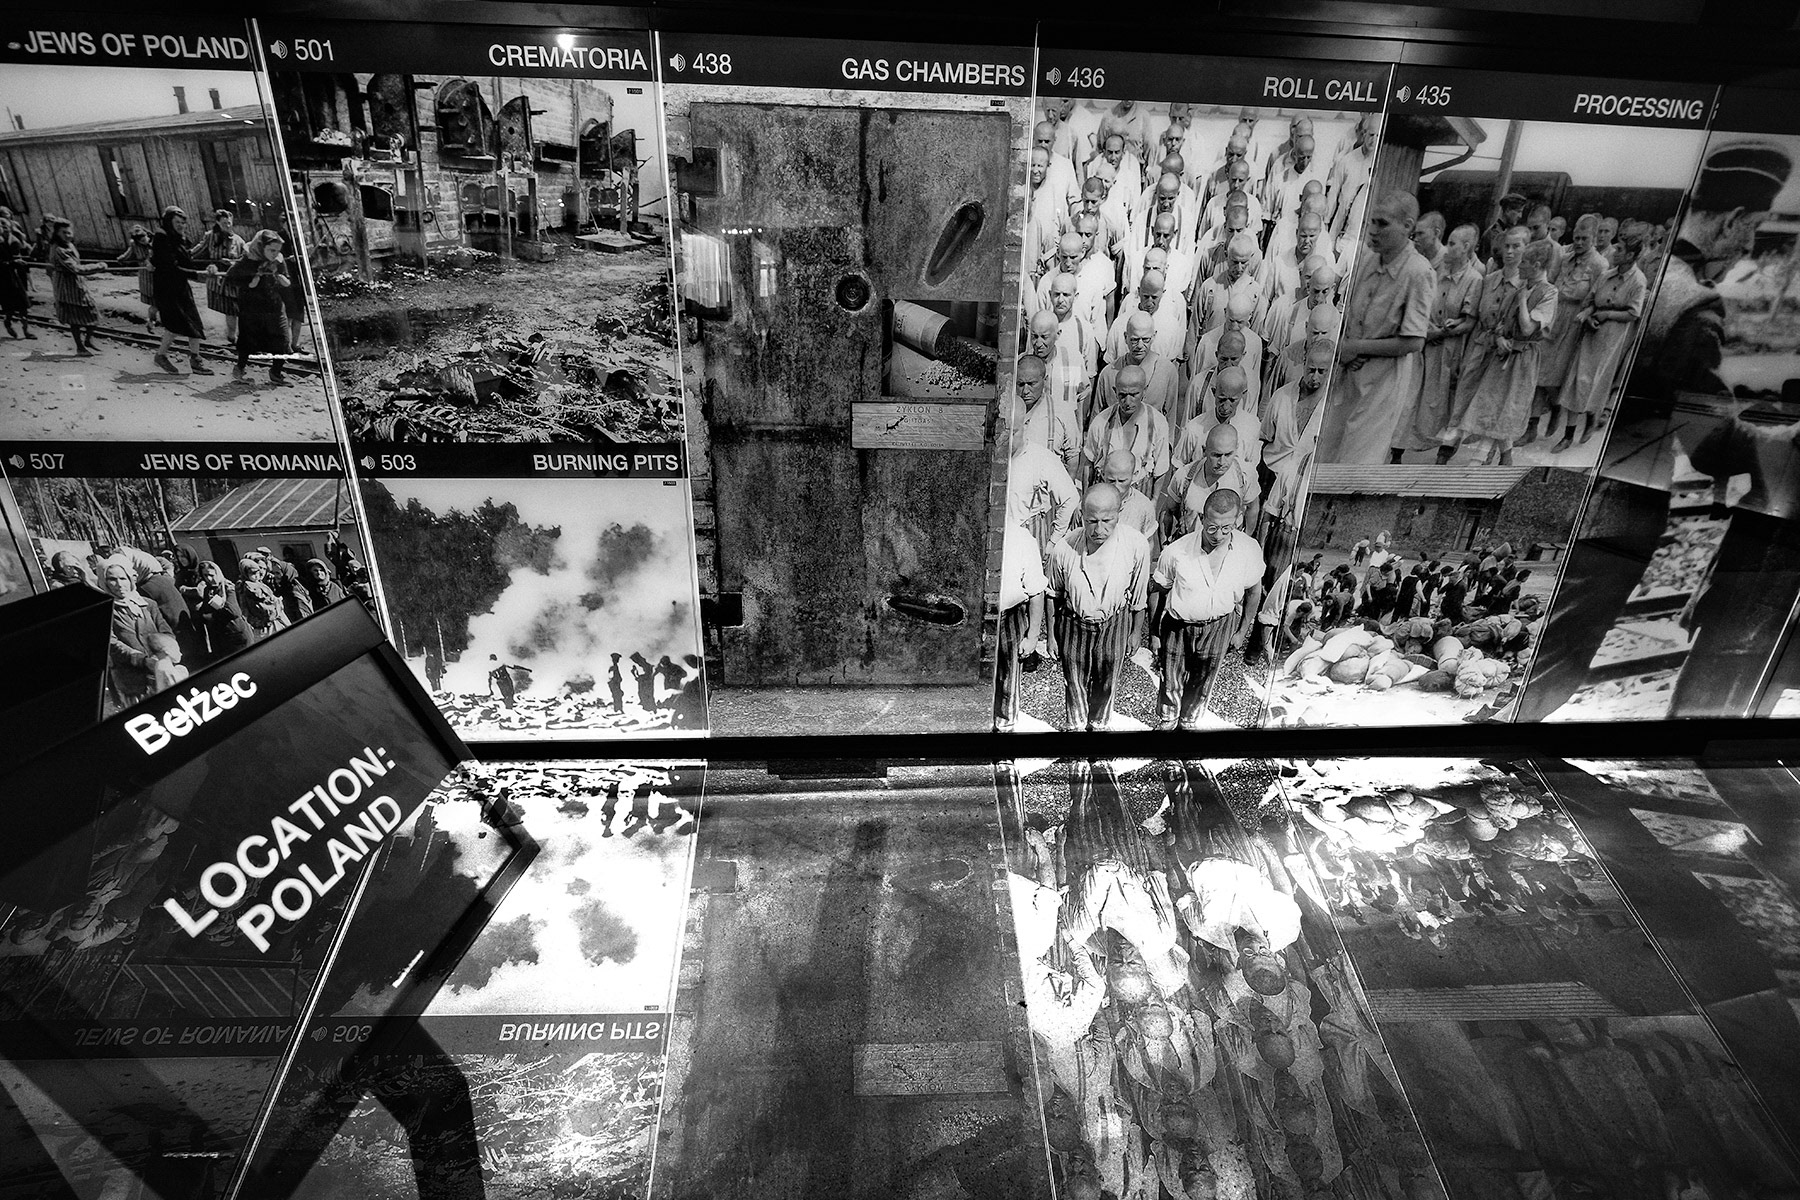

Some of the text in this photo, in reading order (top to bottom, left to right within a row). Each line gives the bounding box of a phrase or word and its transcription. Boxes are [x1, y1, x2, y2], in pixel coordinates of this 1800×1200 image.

[24, 30, 250, 60] JEWS OF POLAND
[294, 38, 648, 71] 501 CREMATORIA
[692, 53, 1026, 87] 438 GAS CHAMBERS
[1067, 67, 1378, 102] 436 ROLL CALL
[1415, 85, 1704, 120] 435 PROCESSING
[30, 453, 343, 472] 507 JEWS OF ROMANIA
[381, 454, 679, 471] 503 BURNING PITS
[163, 746, 396, 938] LOCATION:
[237, 795, 402, 953] POLAND
